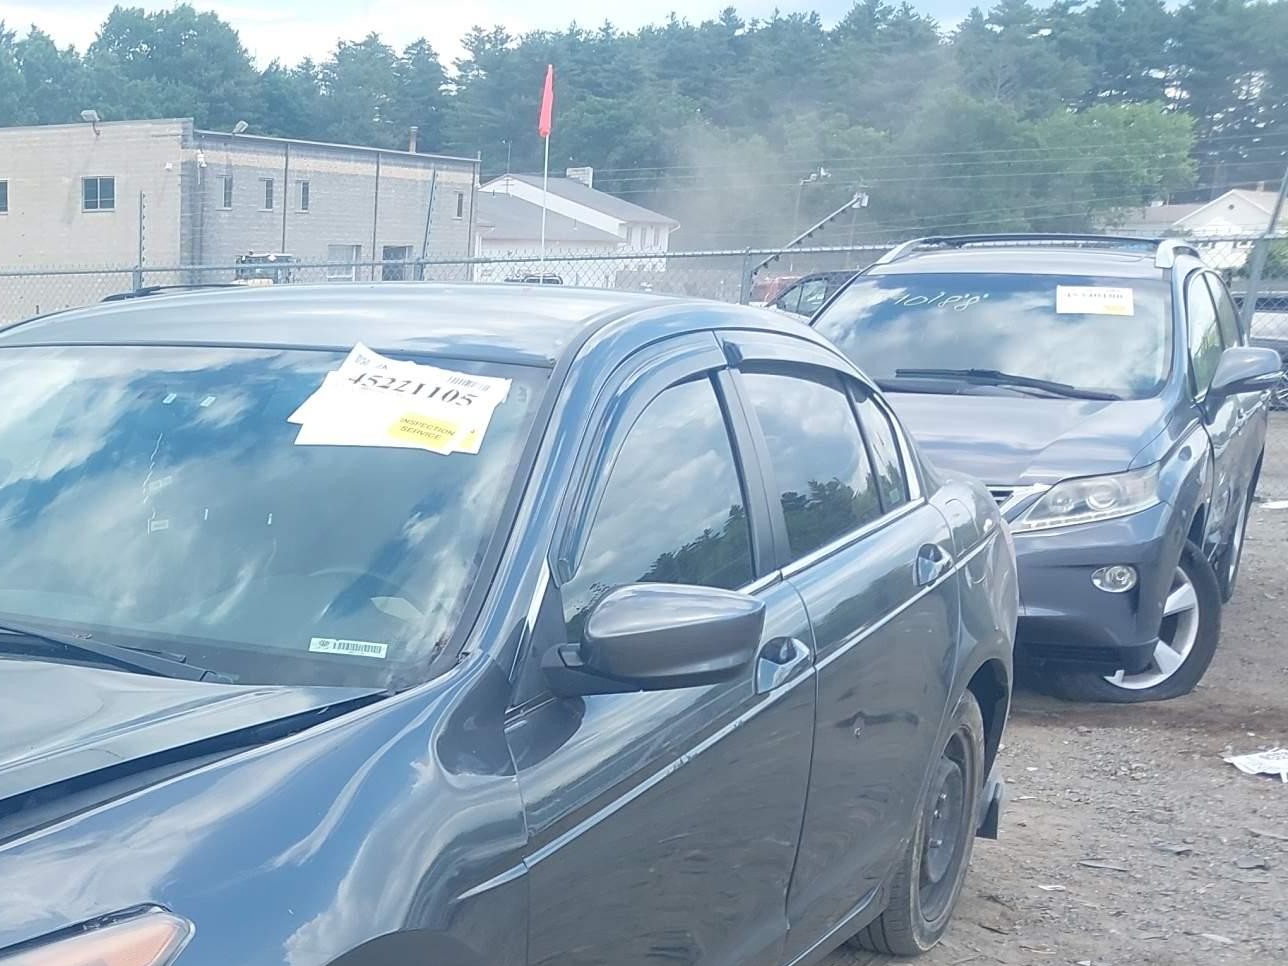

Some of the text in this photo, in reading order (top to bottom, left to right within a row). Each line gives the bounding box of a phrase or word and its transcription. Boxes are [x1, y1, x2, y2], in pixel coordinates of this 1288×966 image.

[349, 373, 478, 406] 45221105
[400, 417, 456, 436] INSPECTION
[400, 426, 442, 440] SERVICE
